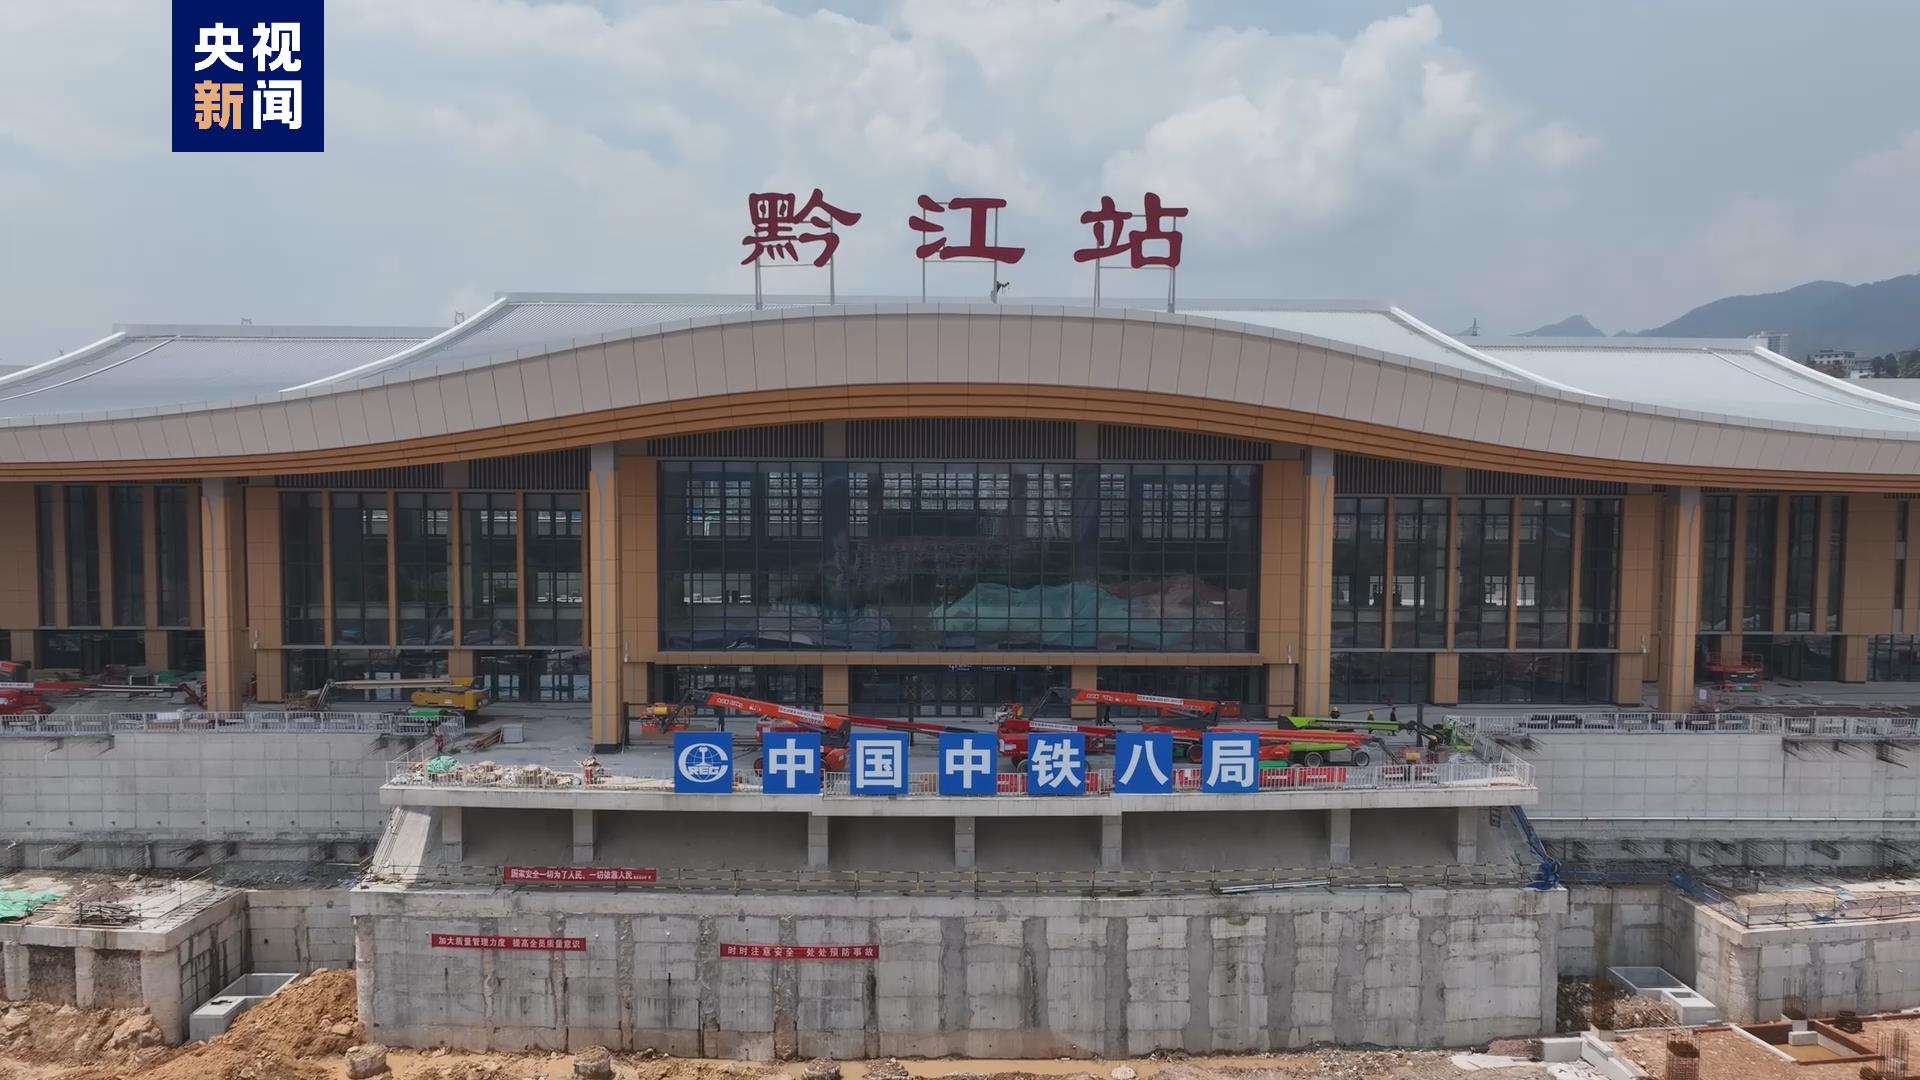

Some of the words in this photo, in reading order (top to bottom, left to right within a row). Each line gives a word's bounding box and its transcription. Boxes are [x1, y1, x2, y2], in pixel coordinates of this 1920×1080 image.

[741, 188, 1188, 267] 黔江站
[768, 738, 1256, 788] 中国中铁八局
[438, 936, 506, 947] 加大质量管理力度
[512, 938, 581, 949] 提高全员质量意识
[727, 946, 795, 957] 时时注意安全
[806, 947, 874, 957] 处处预防事故
